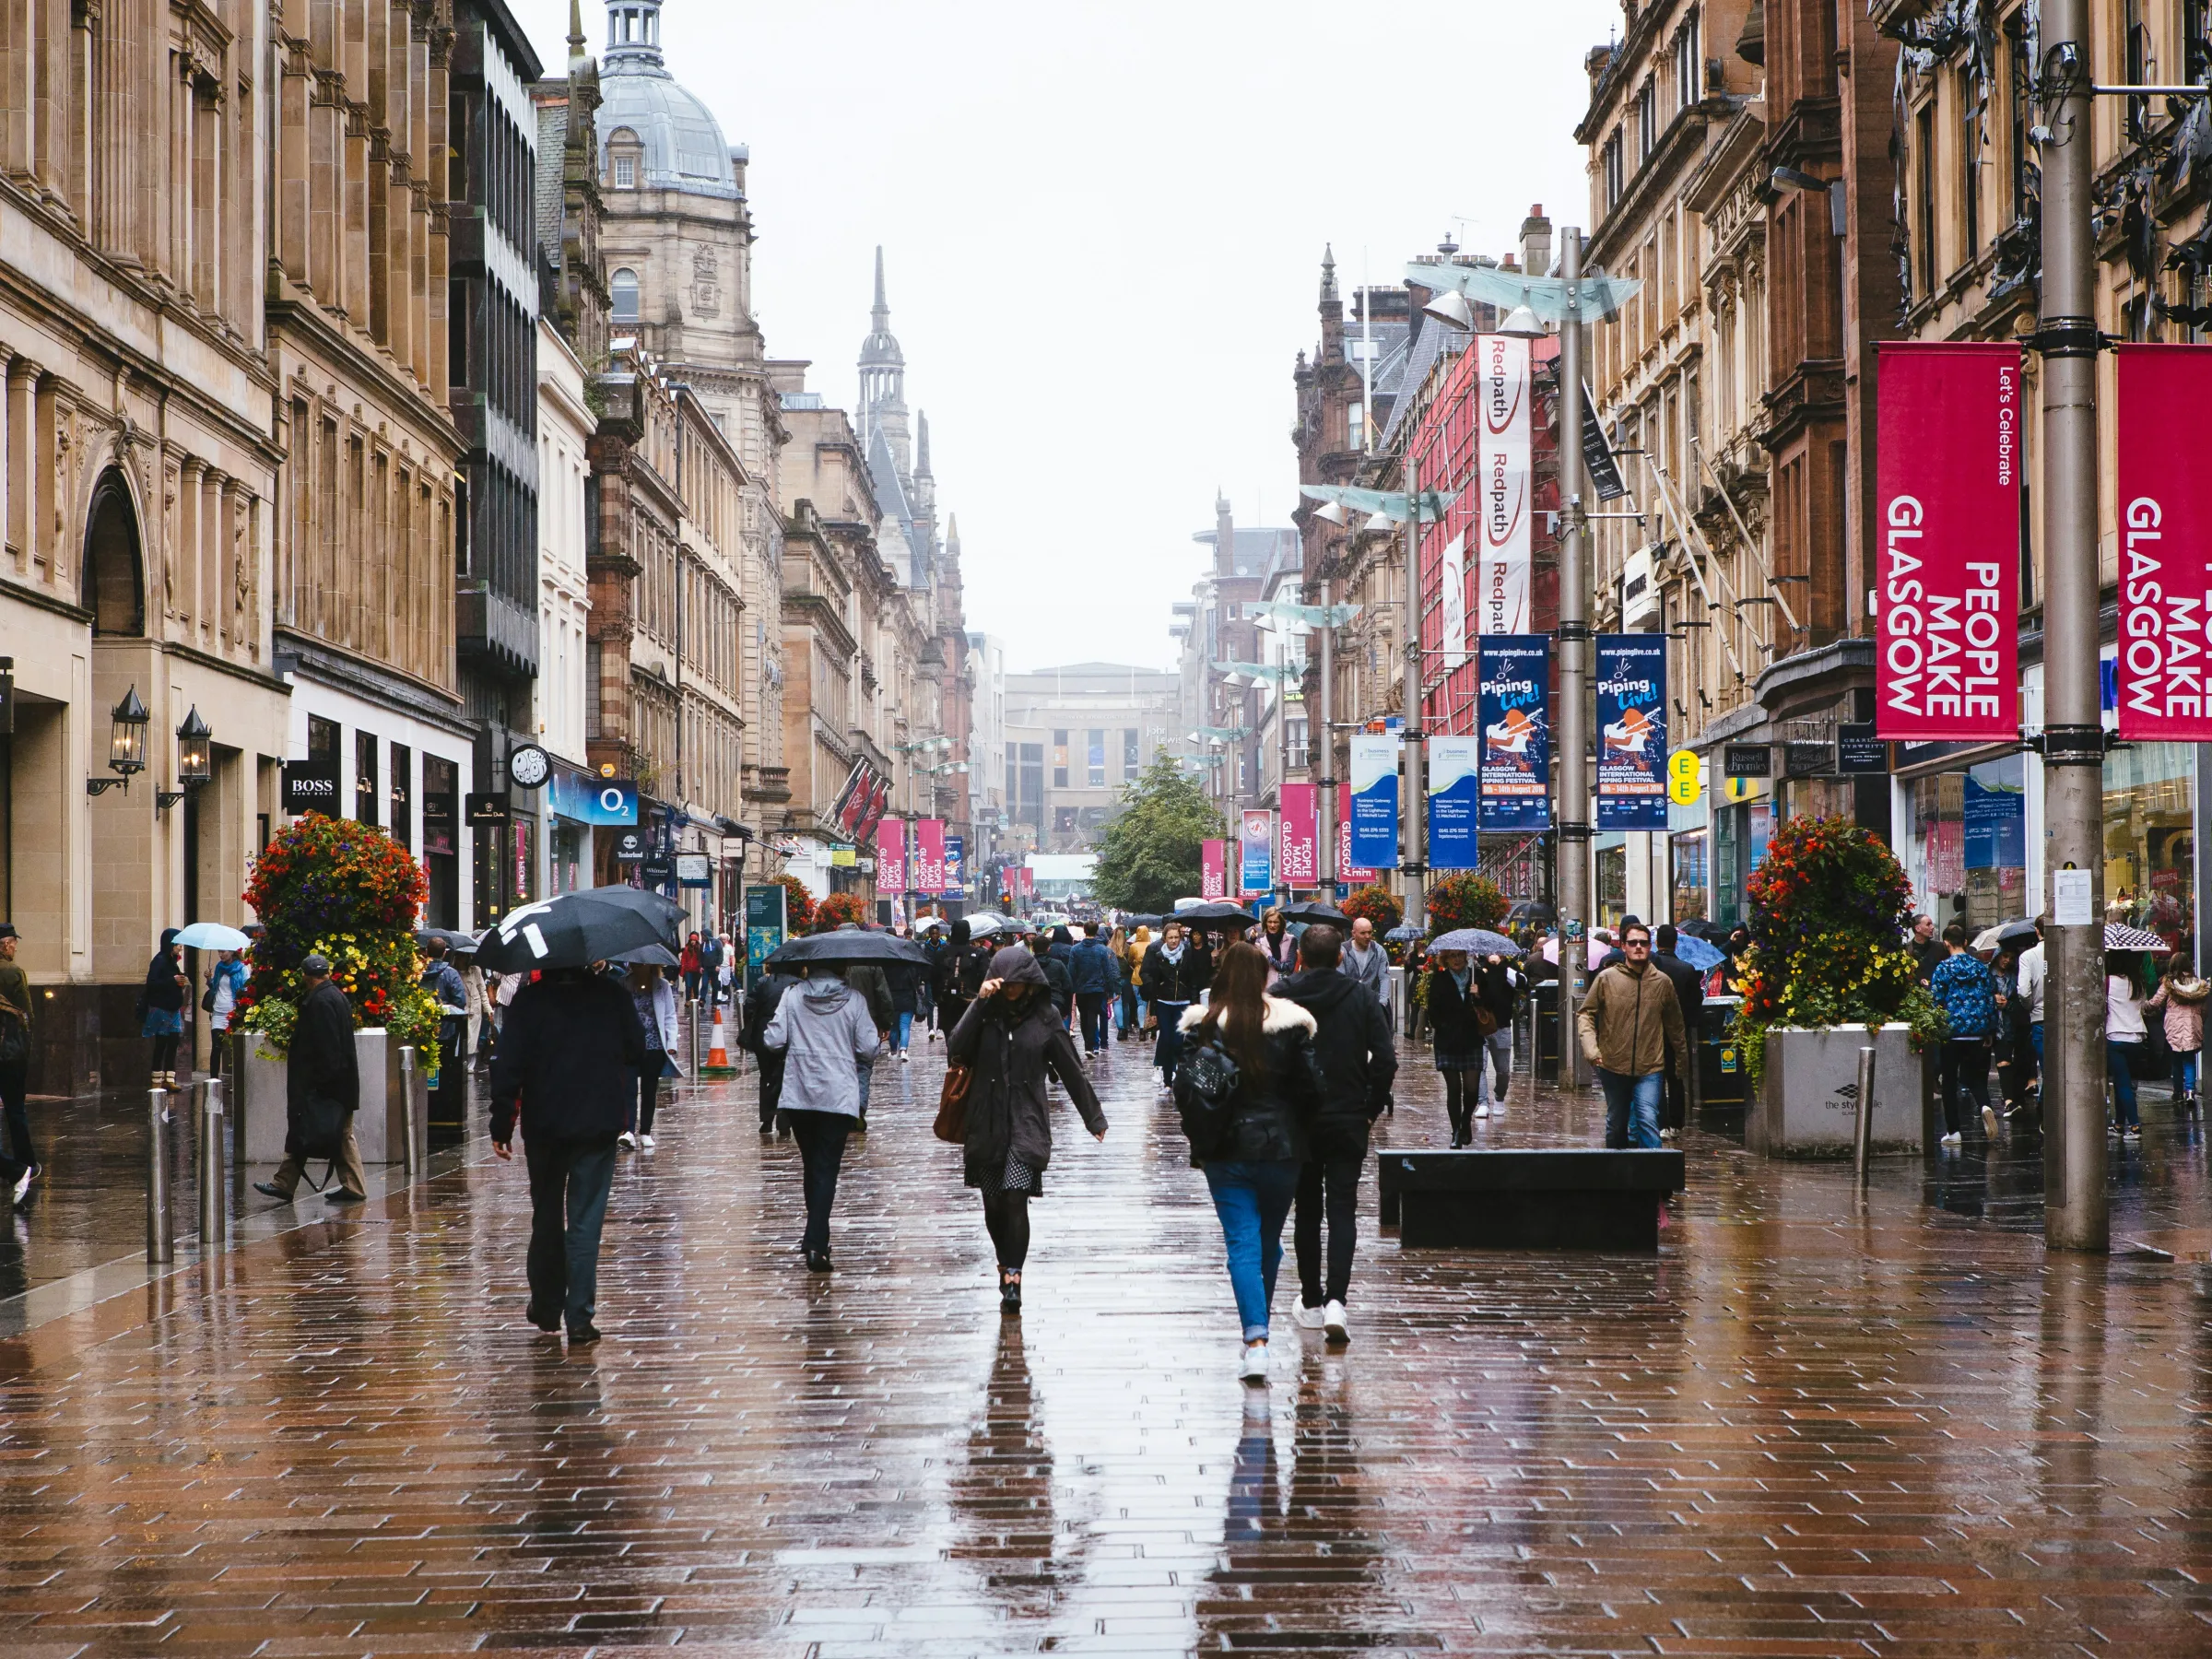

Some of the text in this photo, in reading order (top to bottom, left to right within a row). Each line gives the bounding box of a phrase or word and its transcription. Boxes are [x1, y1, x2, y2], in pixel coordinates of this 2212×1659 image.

[1488, 340, 1509, 418] Redpath
[1999, 367, 2013, 486] Let's Celebrate
[1489, 453, 1509, 533] Redpath
[1888, 495, 1923, 716] GLASGOW
[2126, 497, 2162, 716] GLASGOW
[1483, 649, 1543, 657] www.pipinglive.co.uk
[1600, 648, 1660, 656] www.pipinglive.co.uk
[1927, 595, 1961, 716] MAKE
[1965, 562, 1999, 717] PEOPLE
[2166, 597, 2200, 717] MAKE
[1480, 678, 1533, 697] Piping
[1500, 684, 1540, 711] Live!
[1597, 677, 1650, 697] Piping
[1618, 683, 1658, 710] Live!
[1732, 752, 1762, 761] Russell
[292, 780, 333, 791] BOSS
[1512, 786, 1531, 794] August
[1630, 785, 1649, 794] August
[879, 848, 888, 889] GLASGOW
[919, 848, 927, 888] GLASGOW
[1282, 821, 1291, 877] GLASGOW
[1292, 846, 1301, 877] MAKE
[1302, 838, 1312, 877] PEOPLE
[1342, 821, 1350, 877] GLASGOW
[1825, 1100, 1839, 1109] the
